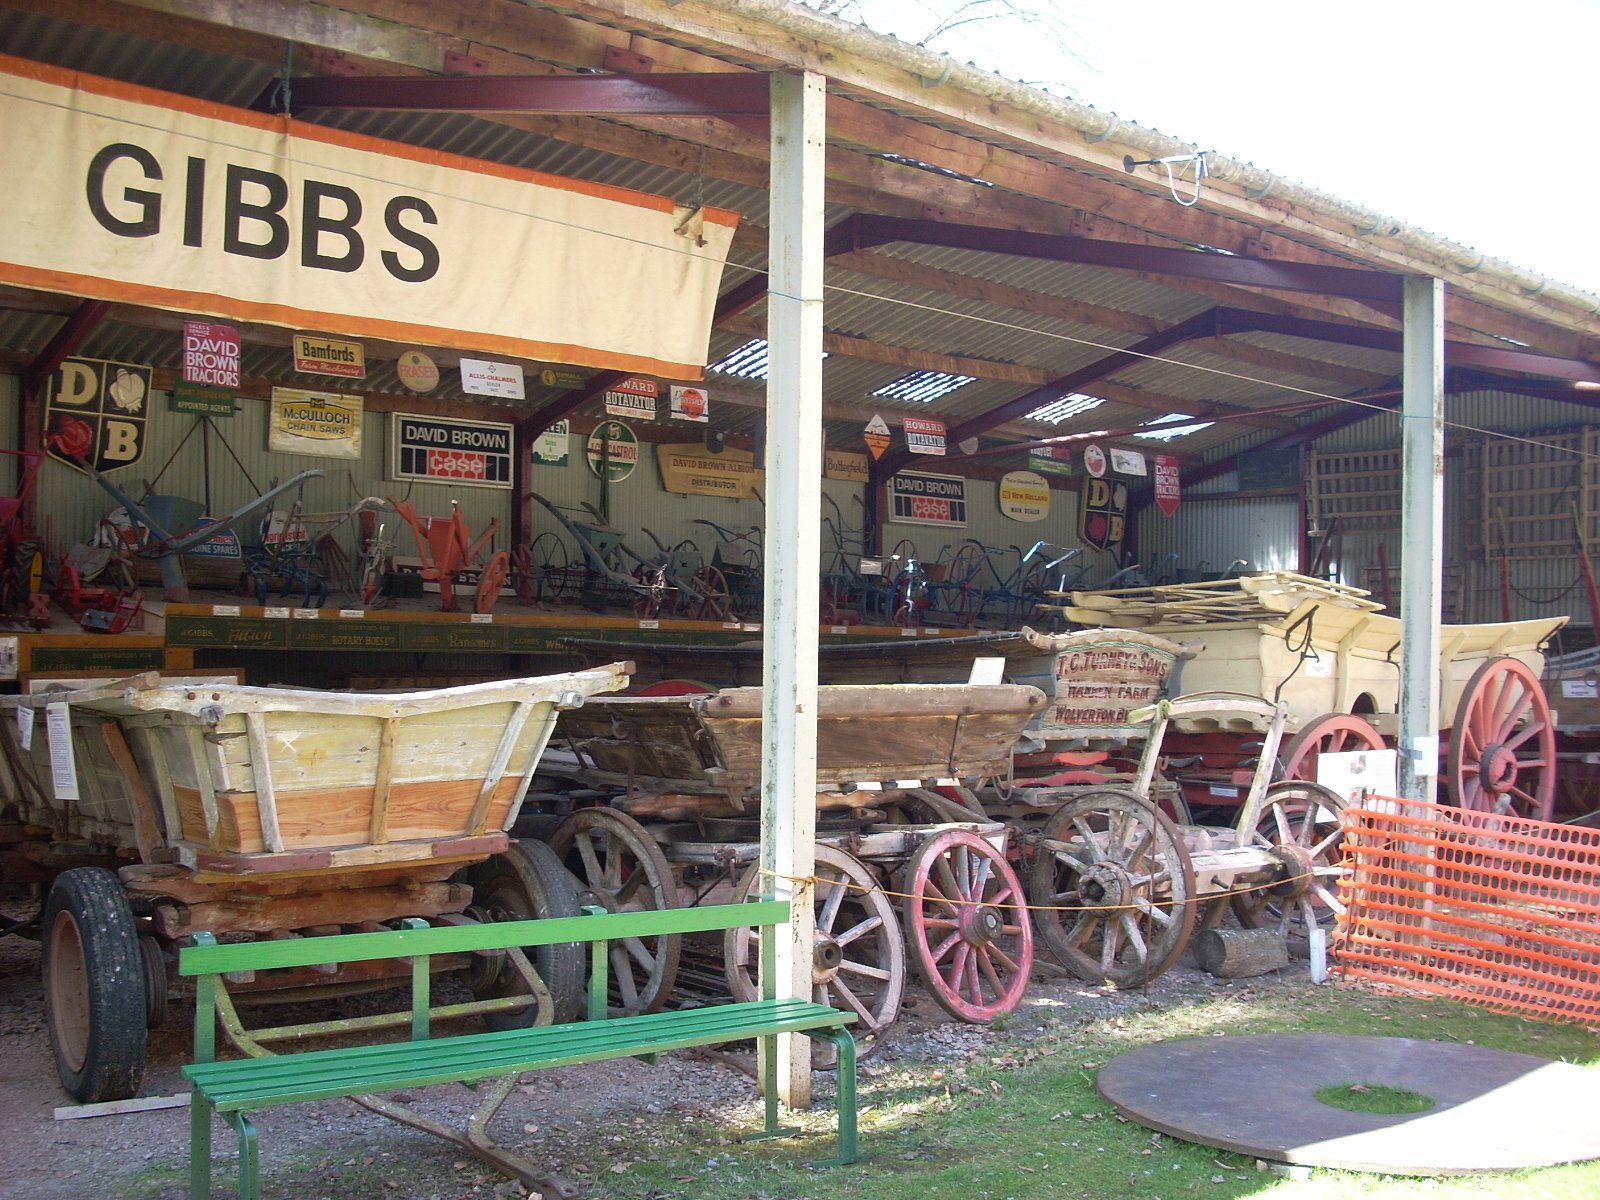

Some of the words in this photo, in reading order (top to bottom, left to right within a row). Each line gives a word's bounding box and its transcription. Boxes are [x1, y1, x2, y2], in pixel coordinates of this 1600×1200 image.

[86, 142, 440, 283] GIBBS
[186, 336, 237, 357] DAVID
[302, 341, 355, 363] Bamfords
[186, 353, 237, 372] BROWN
[186, 364, 237, 387] TRACTORS
[399, 365, 436, 378] FRASER
[468, 373, 517, 384] ALLIS-CHALMERS
[57, 363, 98, 405] D
[615, 380, 656, 393] WARD
[605, 391, 656, 411] ROTAVATOR
[283, 408, 351, 425] McCULLOCH
[287, 422, 317, 433] CHAIN
[319, 425, 346, 436] SAWS
[905, 420, 943, 432] HOWARD
[103, 420, 138, 461] B
[405, 425, 448, 443] DAVID
[451, 430, 506, 449] BROWN
[907, 432, 946, 447] ROTAVATOR
[672, 458, 695, 469] DAVID
[696, 460, 726, 472] BROWN
[727, 463, 756, 474] ALBION
[1156, 465, 1178, 477] DAVID
[692, 478, 737, 490] DISTRIBUTOR
[896, 479, 924, 492] DAVID
[926, 481, 962, 496] BROWN
[1156, 475, 1179, 487] BROWN
[1090, 480, 1110, 507] D
[1156, 485, 1180, 496] TRACTORS
[212, 545, 238, 554] SPARES
[228, 629, 273, 643] Albion
[447, 633, 496, 648] Ransomes
[1136, 652, 1166, 677] SONS
